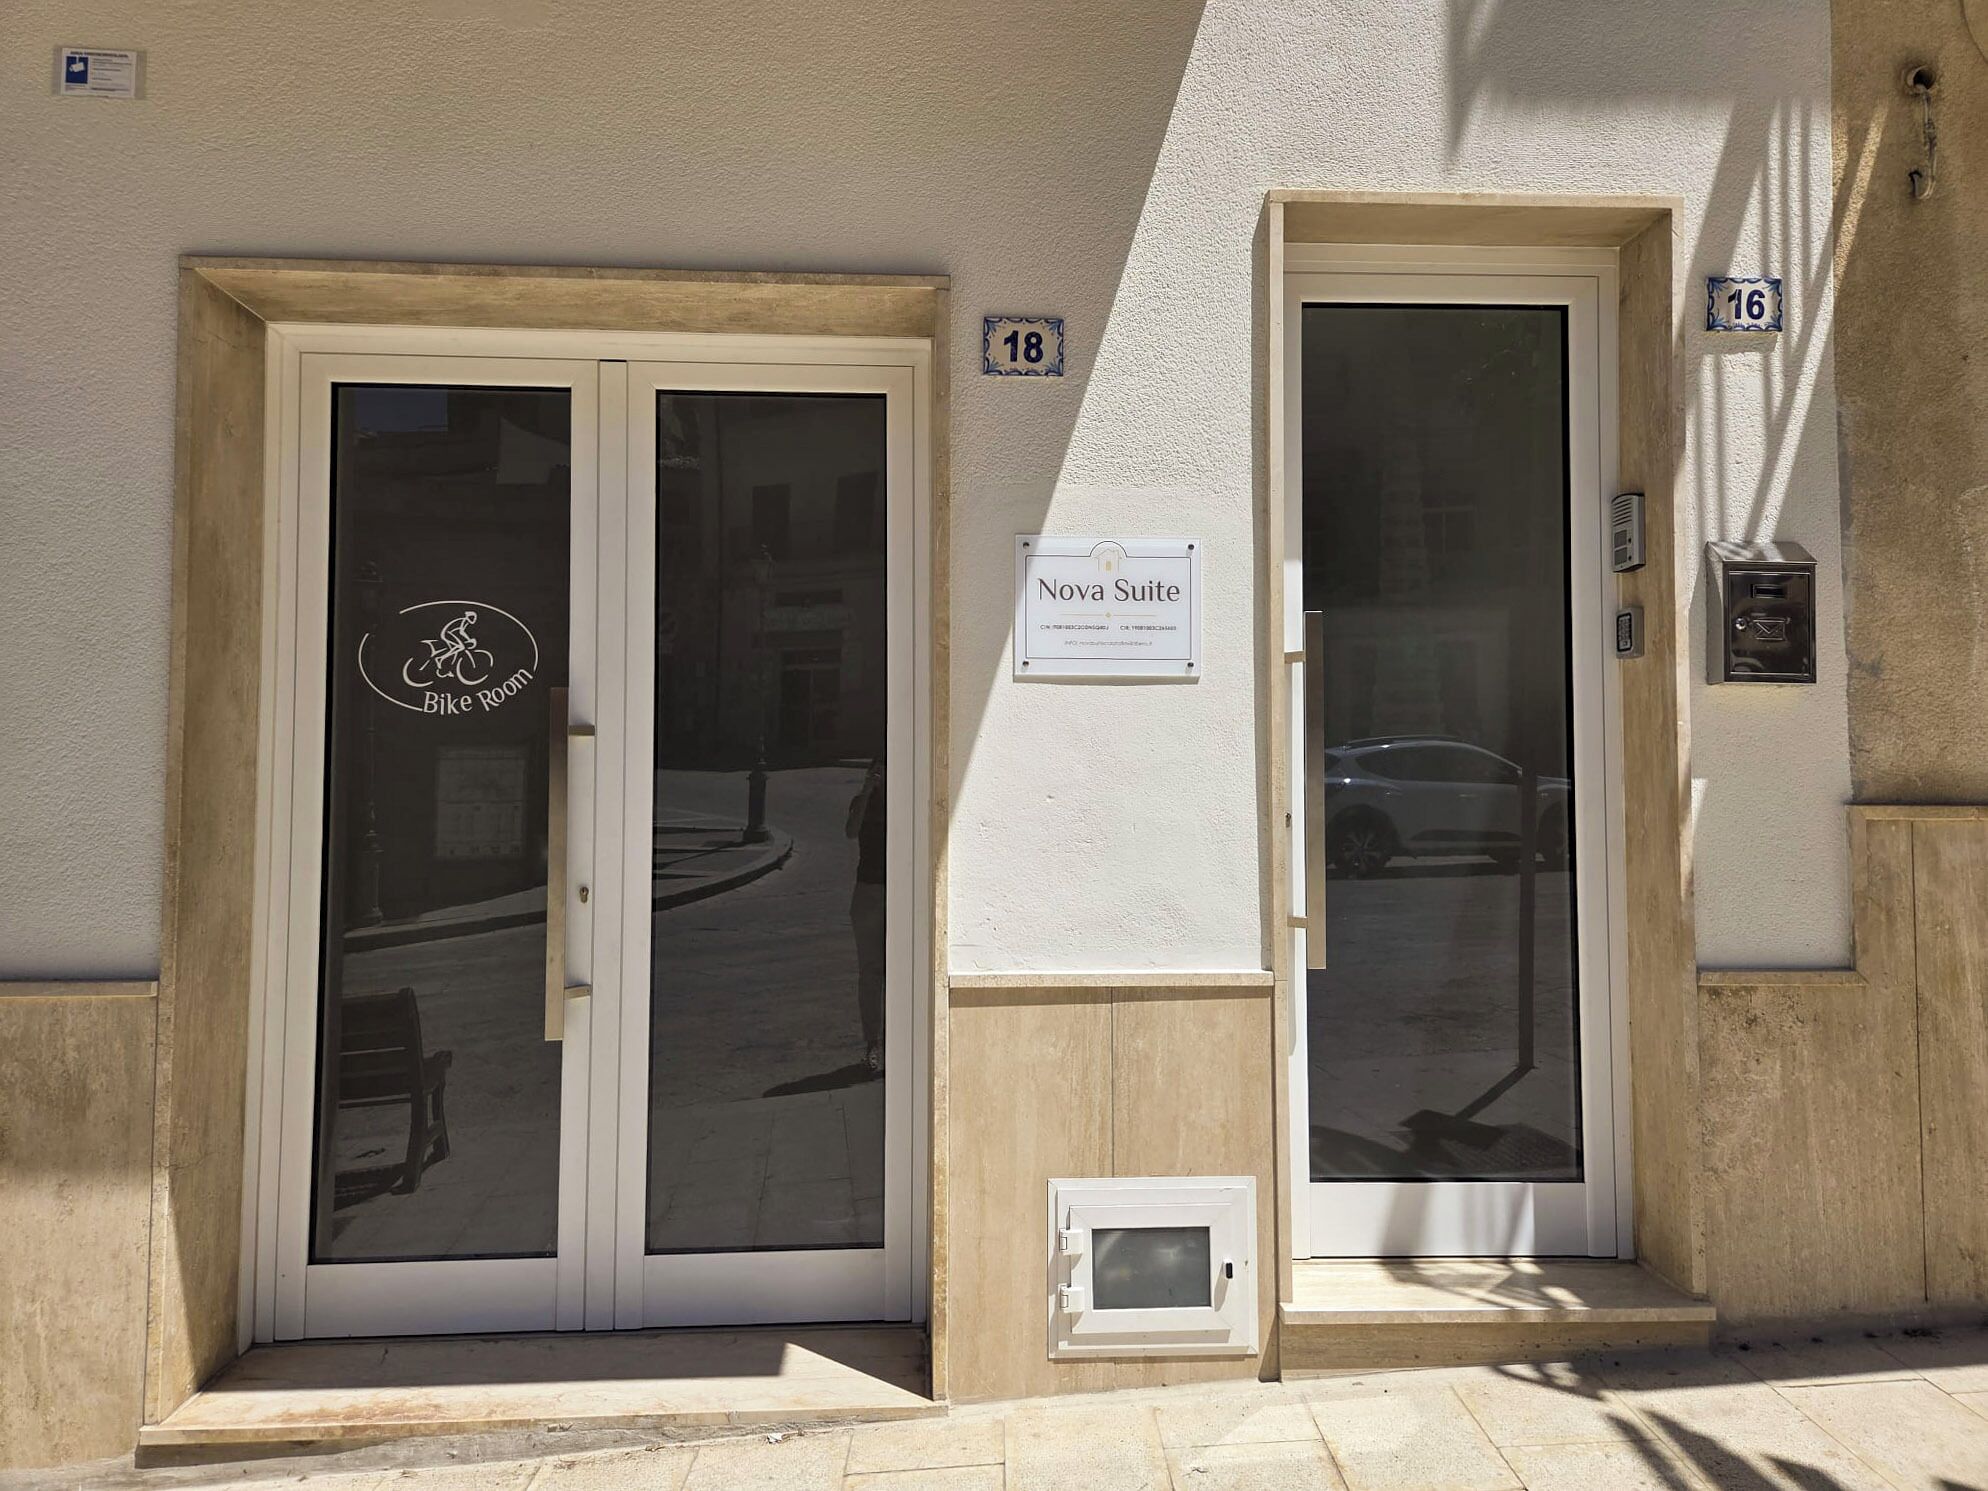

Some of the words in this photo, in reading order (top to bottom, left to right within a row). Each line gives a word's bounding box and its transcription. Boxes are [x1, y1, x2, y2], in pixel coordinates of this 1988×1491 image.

[1727, 288, 1765, 320] 16
[1003, 330, 1044, 363] 18
[1038, 577, 1105, 601] Nova
[1114, 578, 1180, 602] Suite
[423, 691, 473, 716] Bike
[475, 668, 534, 712] Room
